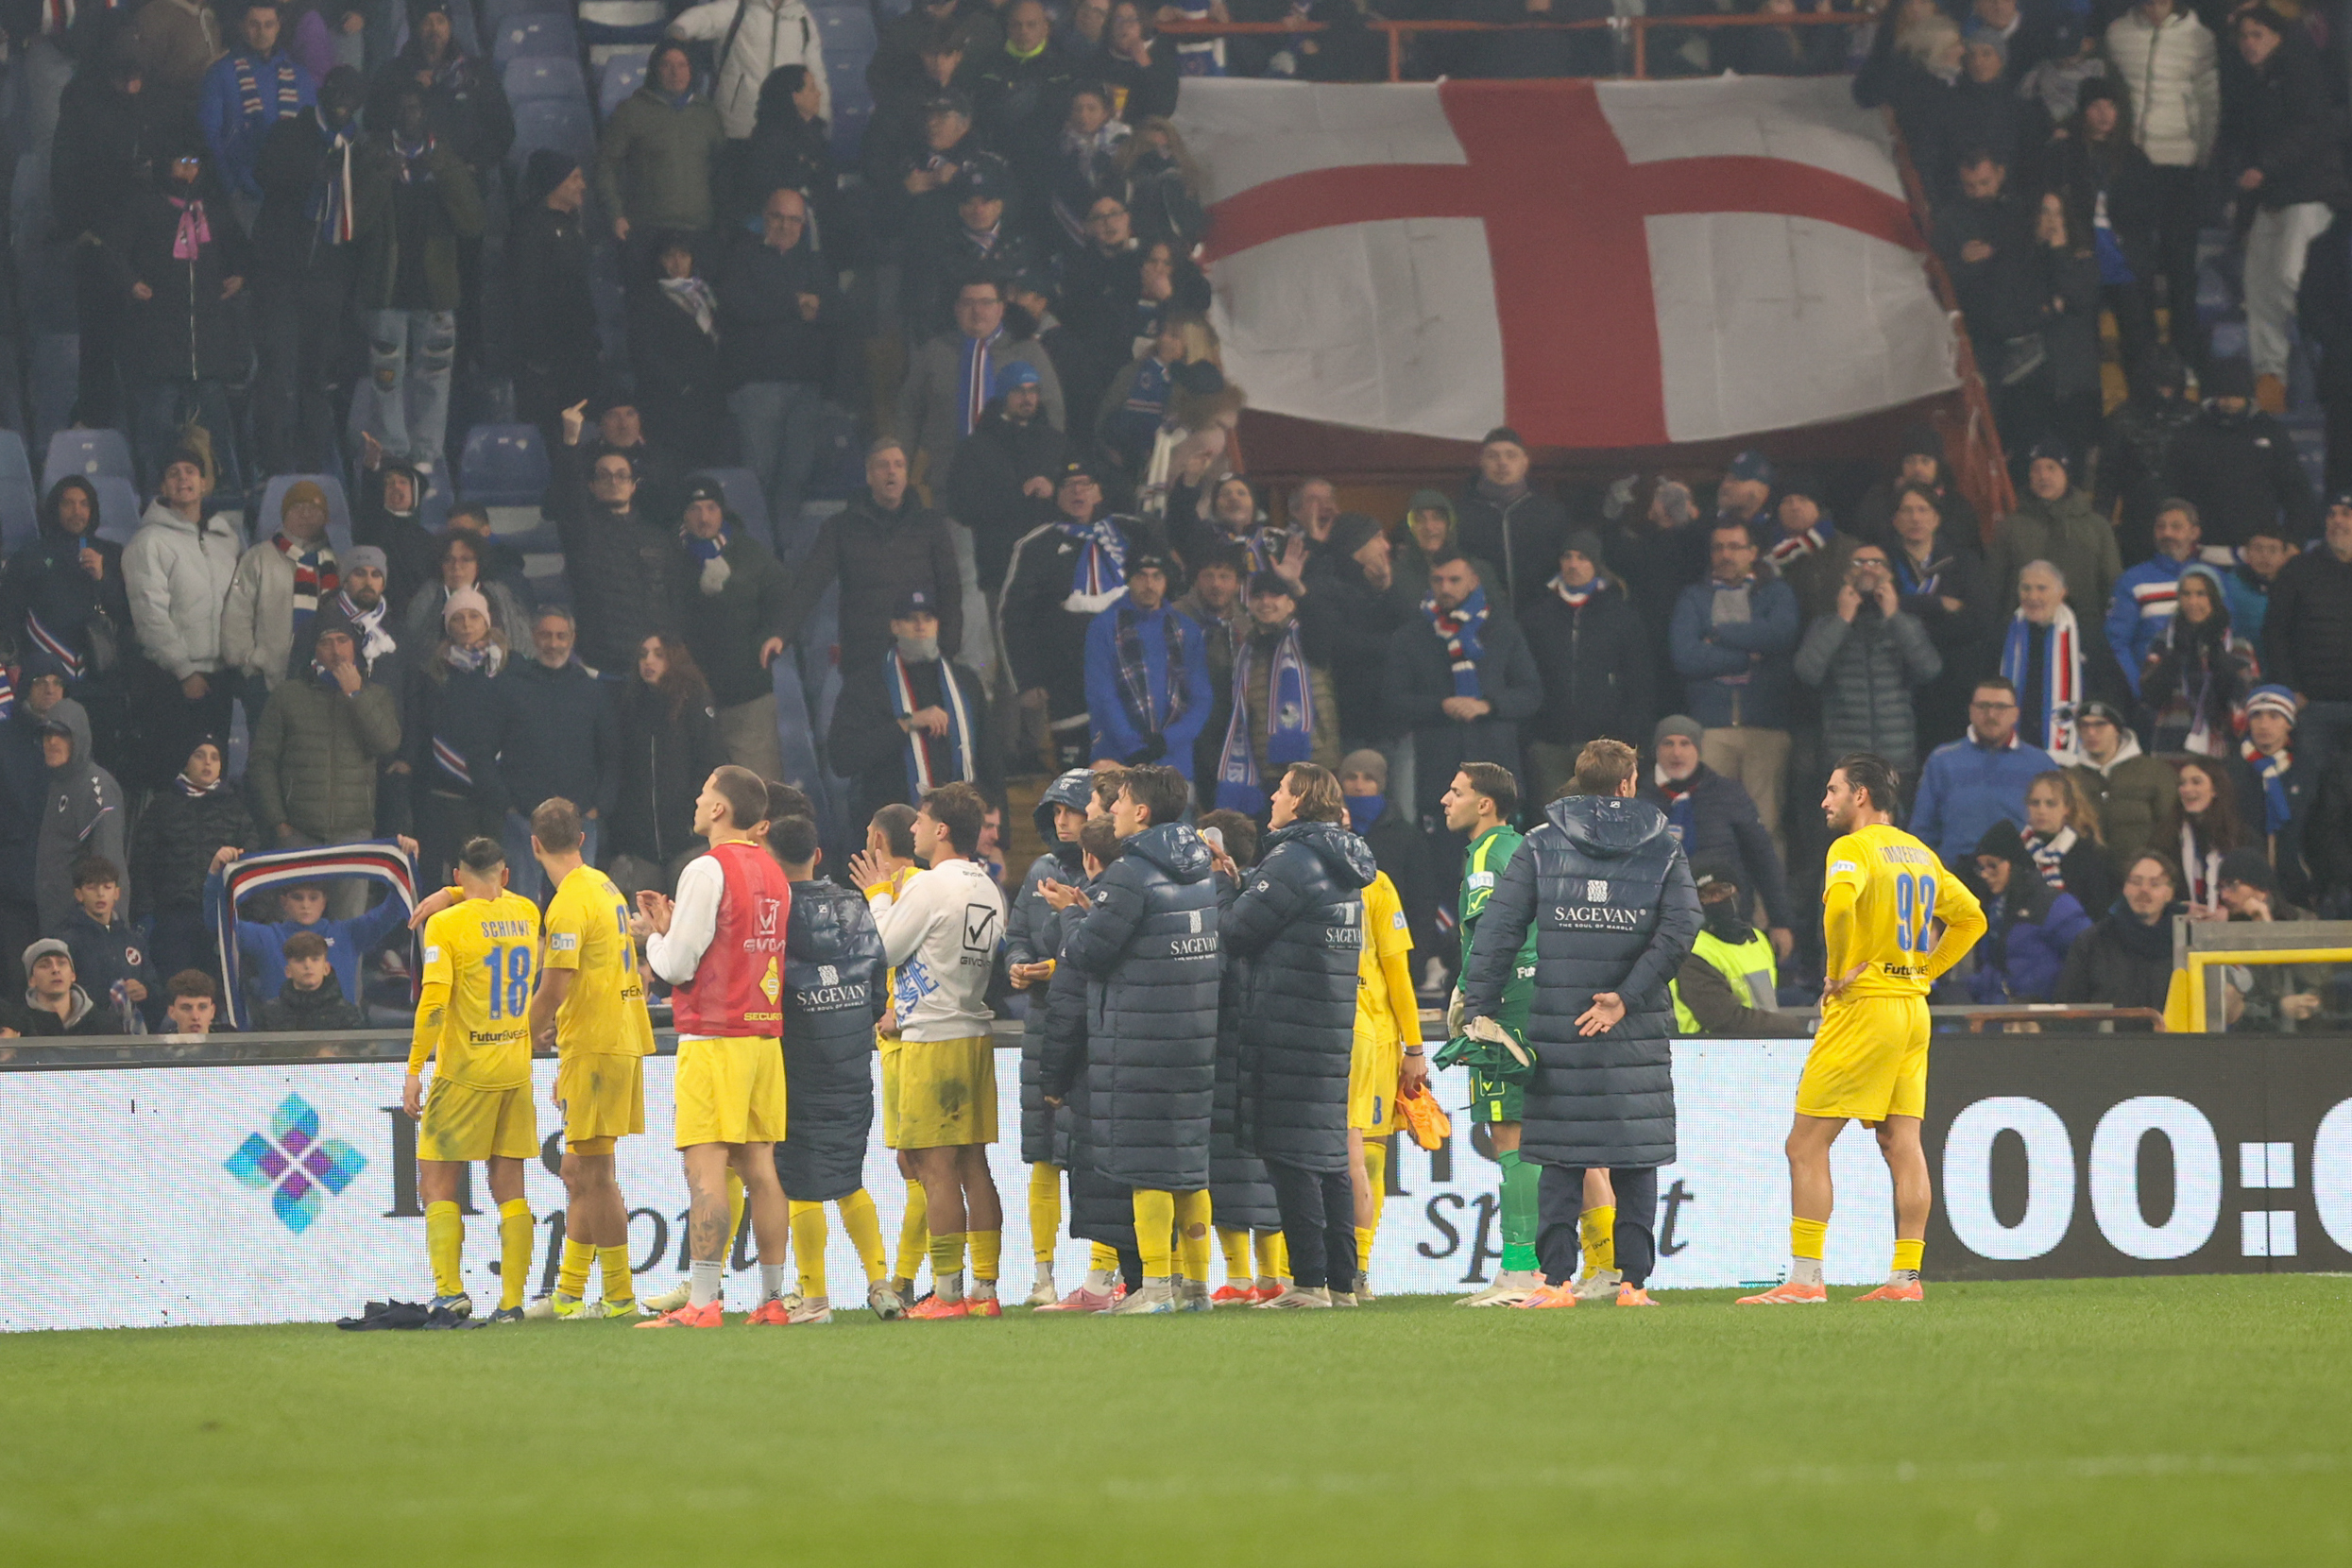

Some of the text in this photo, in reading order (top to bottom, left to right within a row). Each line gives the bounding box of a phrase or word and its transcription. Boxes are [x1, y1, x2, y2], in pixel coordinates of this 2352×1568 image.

[1554, 906, 1637, 924] SAGEVAN
[1897, 873, 1935, 952] 92
[484, 946, 531, 1020] 18
[796, 984, 865, 1006] SAGEVAN
